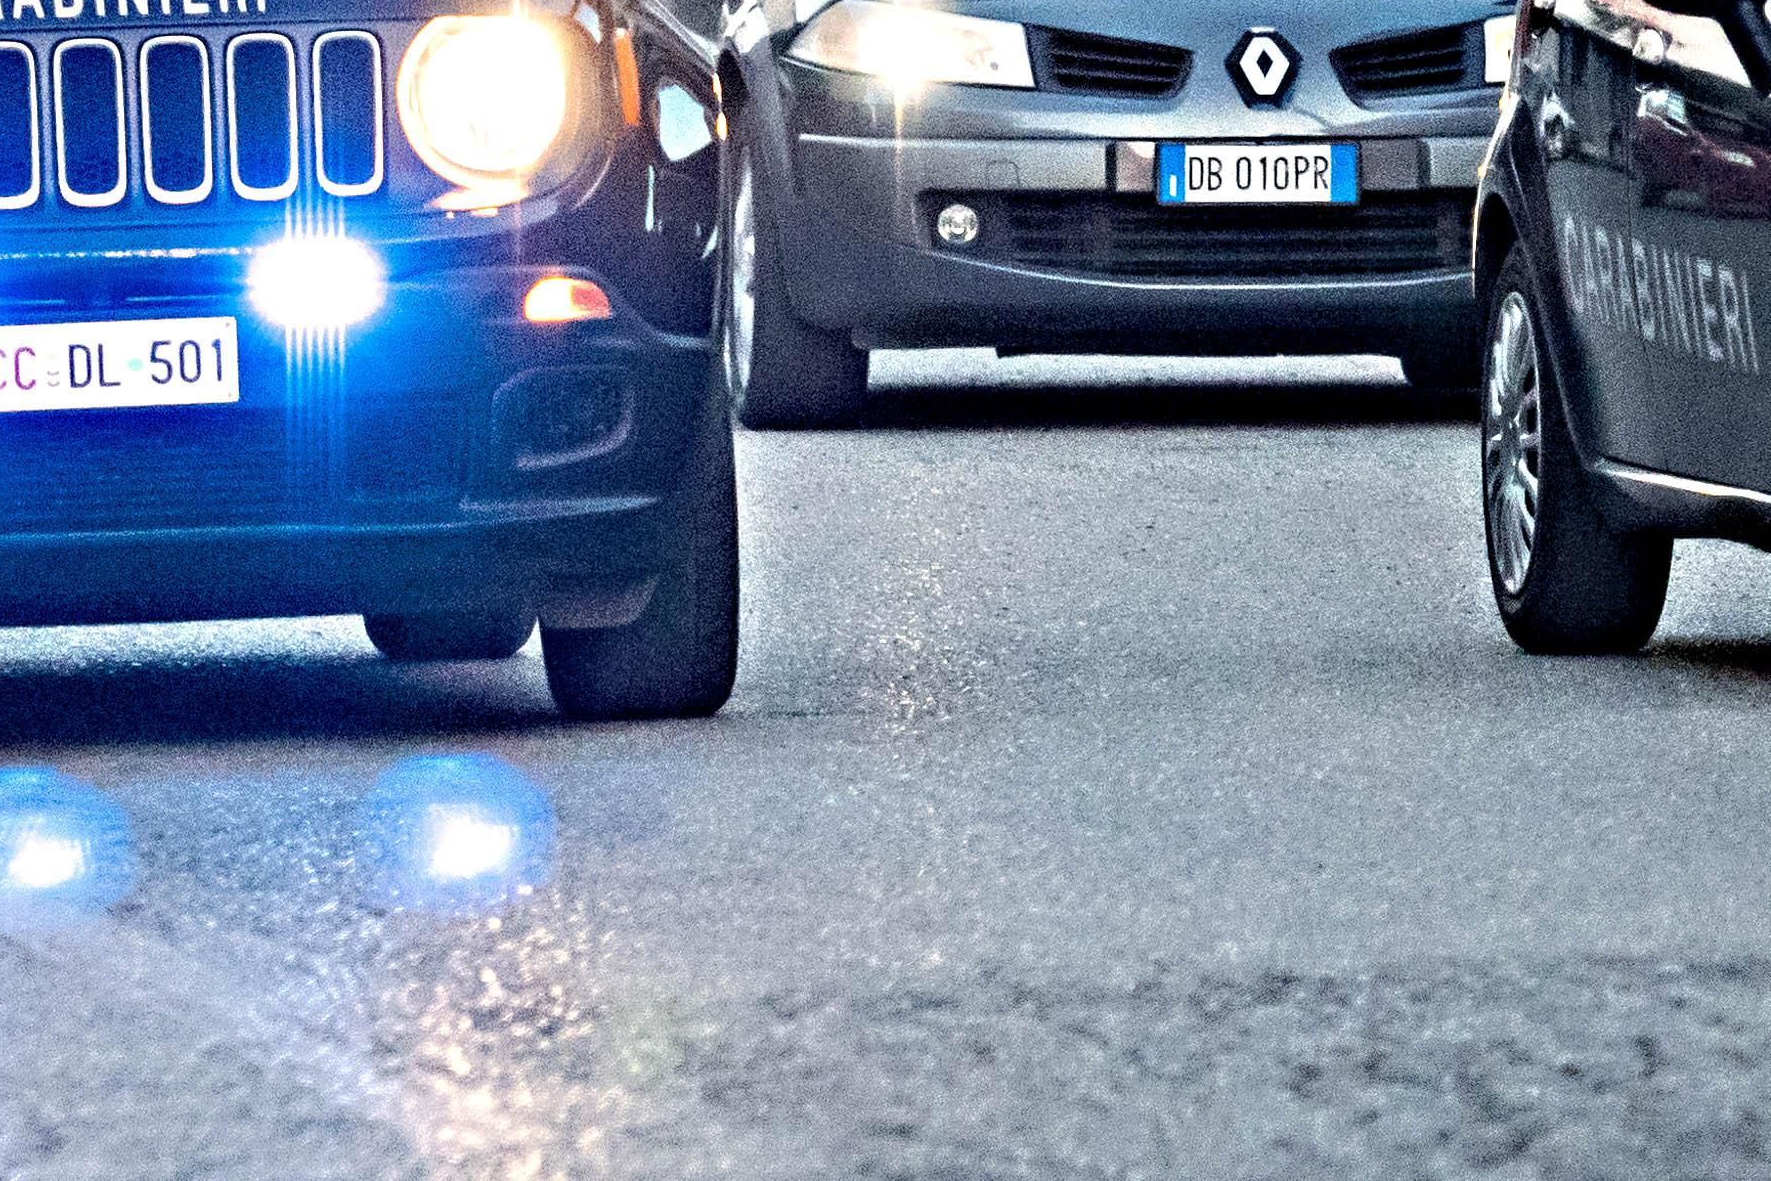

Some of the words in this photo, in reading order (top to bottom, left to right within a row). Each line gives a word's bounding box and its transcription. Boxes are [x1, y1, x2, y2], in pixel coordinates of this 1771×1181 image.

[1188, 156, 1223, 191] DB
[1236, 155, 1329, 191] 010PR
[1562, 216, 1760, 373] CARABINIERI
[68, 343, 121, 388] DL
[150, 338, 223, 384] 501
